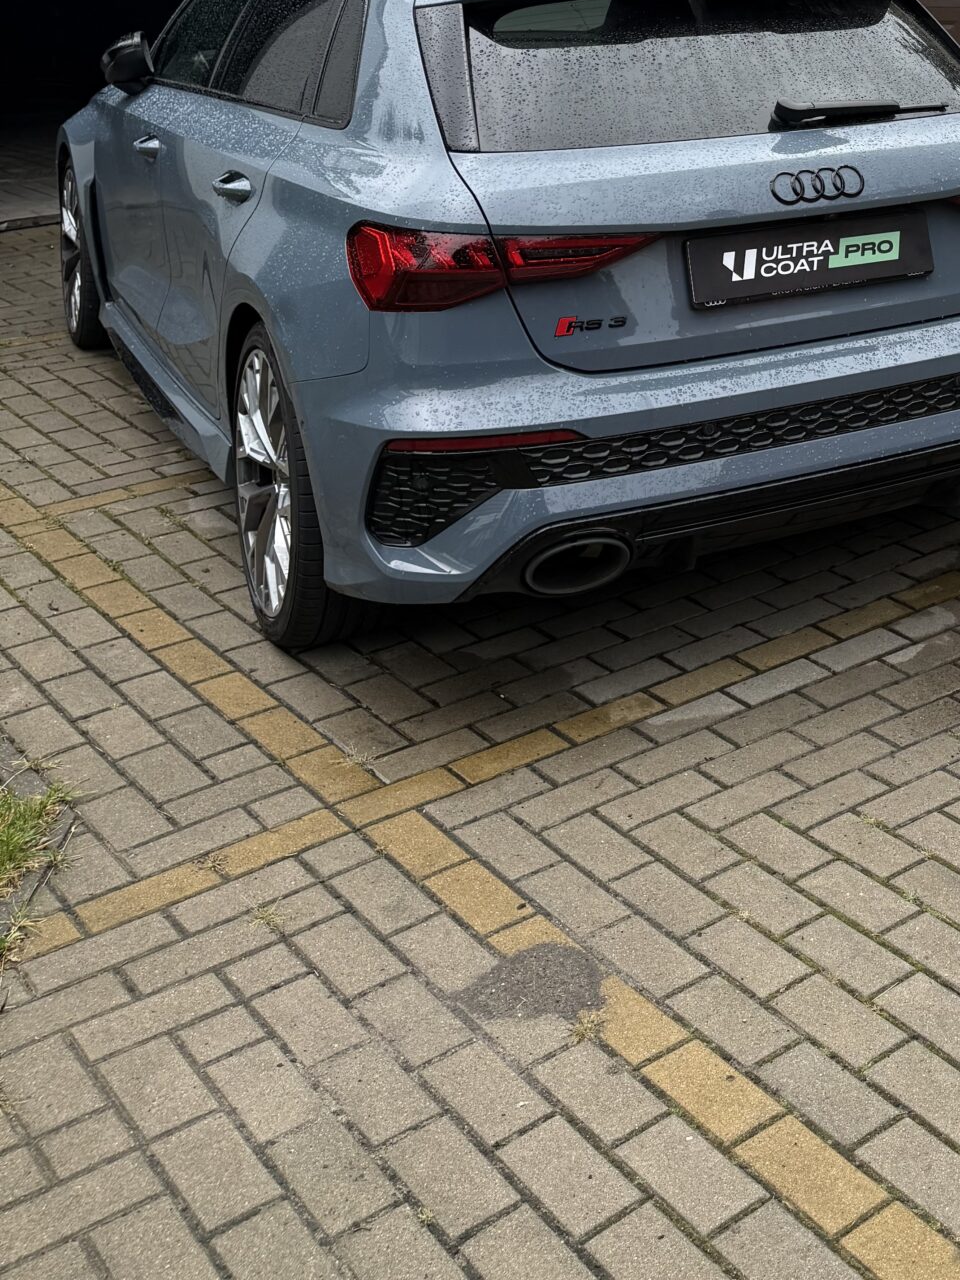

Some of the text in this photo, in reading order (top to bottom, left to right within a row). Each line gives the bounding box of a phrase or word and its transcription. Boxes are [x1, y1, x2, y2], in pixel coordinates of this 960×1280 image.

[761, 239, 834, 261] ULTRA
[844, 239, 894, 259] PRO
[760, 256, 824, 278] COAT
